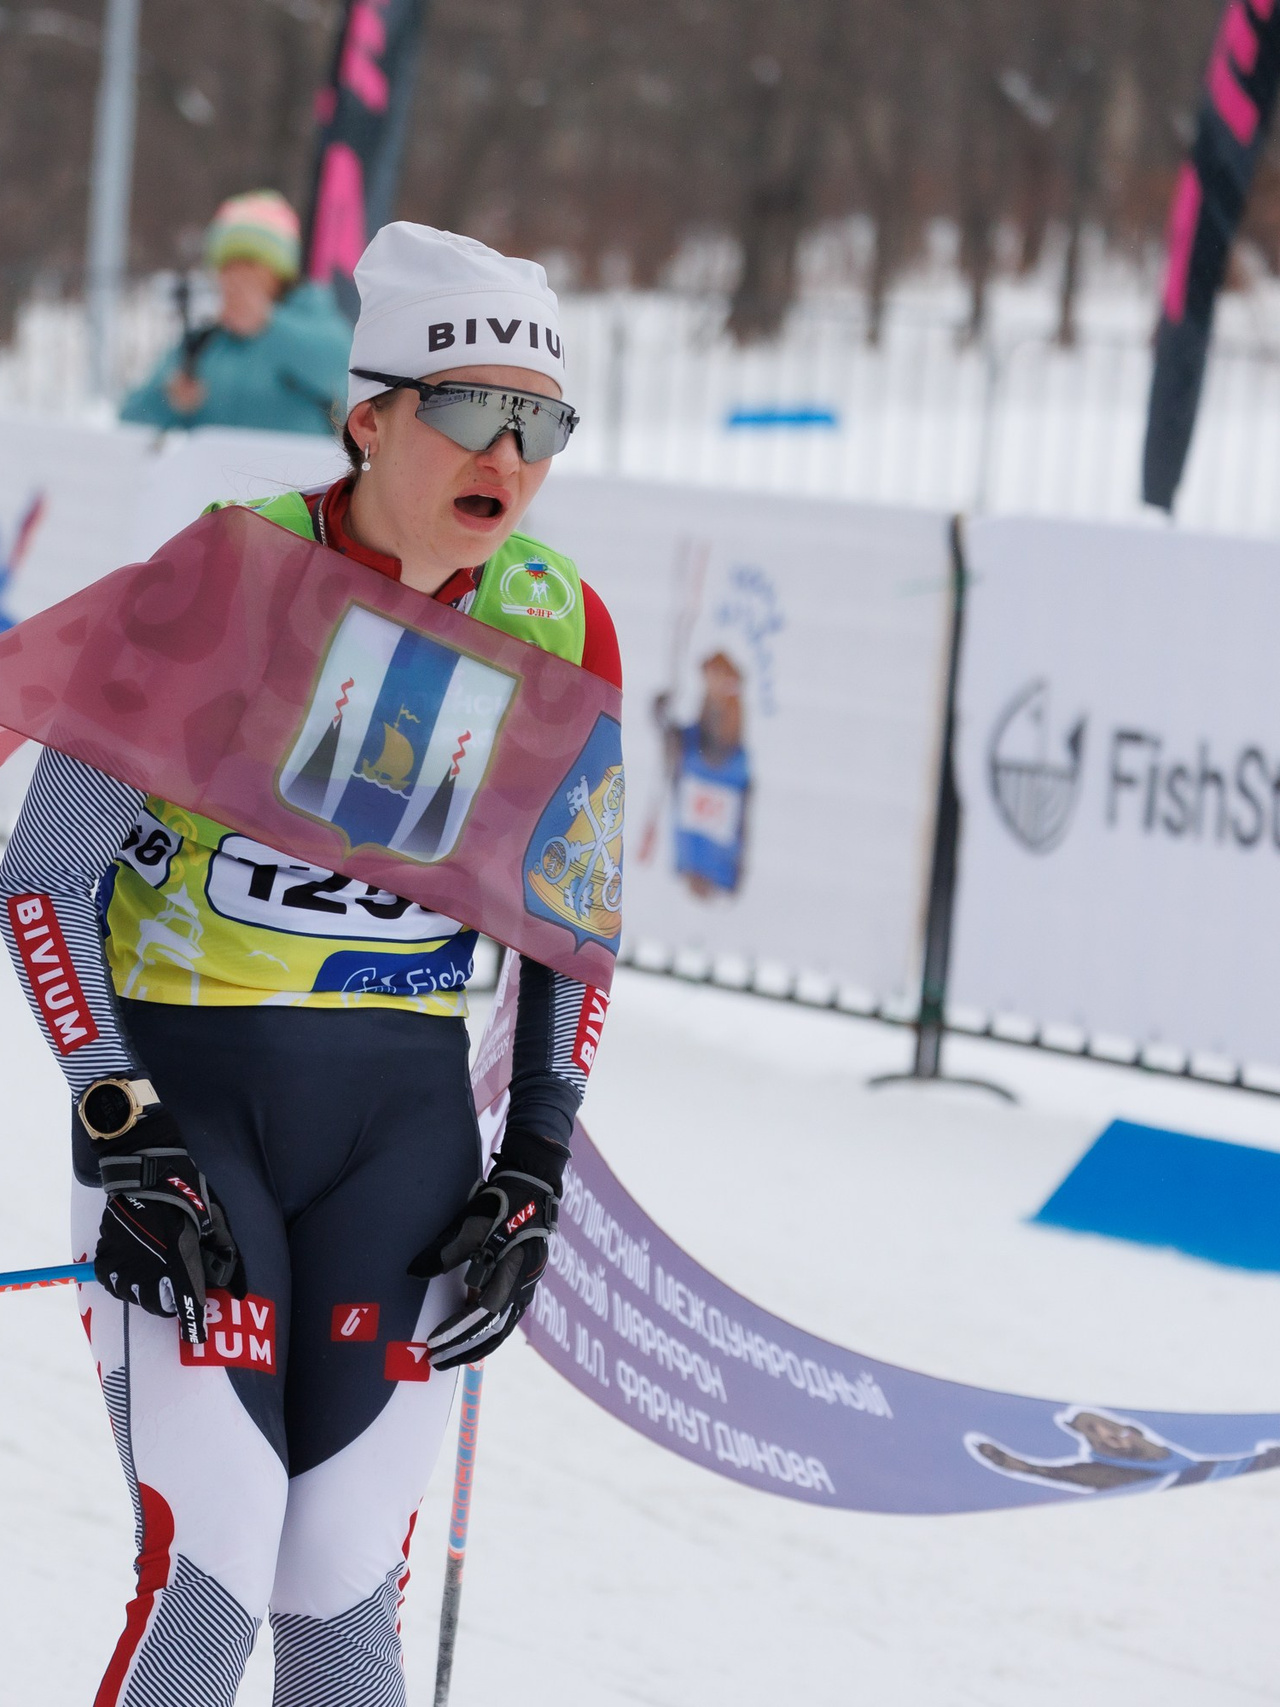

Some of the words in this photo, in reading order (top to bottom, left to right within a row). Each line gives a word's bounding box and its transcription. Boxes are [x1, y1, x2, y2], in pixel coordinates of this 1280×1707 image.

[428, 318, 565, 369] BIVIU
[16, 897, 88, 1046] BIVIUM
[183, 1294, 195, 1320] SKI
[187, 1321, 199, 1344] TIME
[613, 1291, 728, 1404] МАРАФОН
[655, 1265, 894, 1420] МЕЖДУНАРОДНЫЙ
